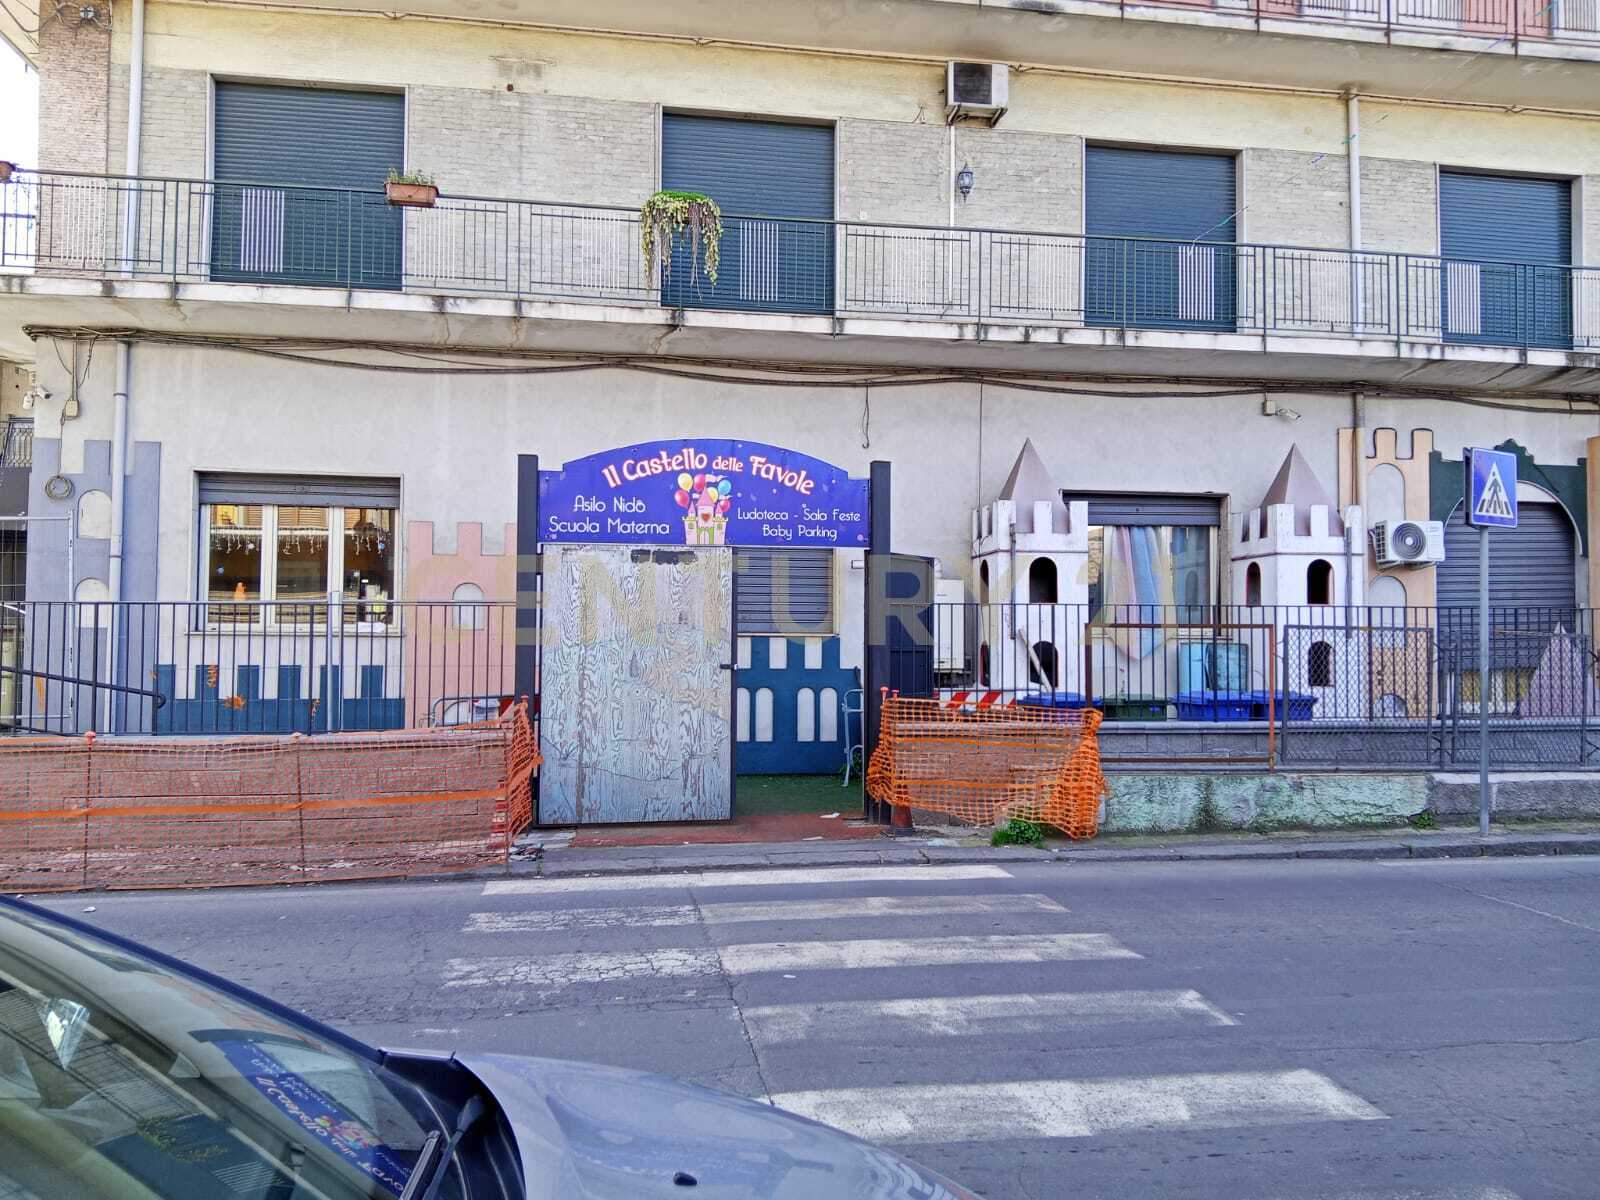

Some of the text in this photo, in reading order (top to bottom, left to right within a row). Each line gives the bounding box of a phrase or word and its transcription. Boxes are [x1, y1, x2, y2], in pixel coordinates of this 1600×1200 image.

[602, 447, 815, 495] Il Castello delle Favole
[573, 495, 646, 513] Asilo Nido
[737, 507, 789, 521] Ludoteca
[803, 507, 828, 521] Sala
[832, 509, 861, 521] Feste
[549, 516, 670, 535] Scuola Materna
[763, 524, 838, 541] Baby Parking
